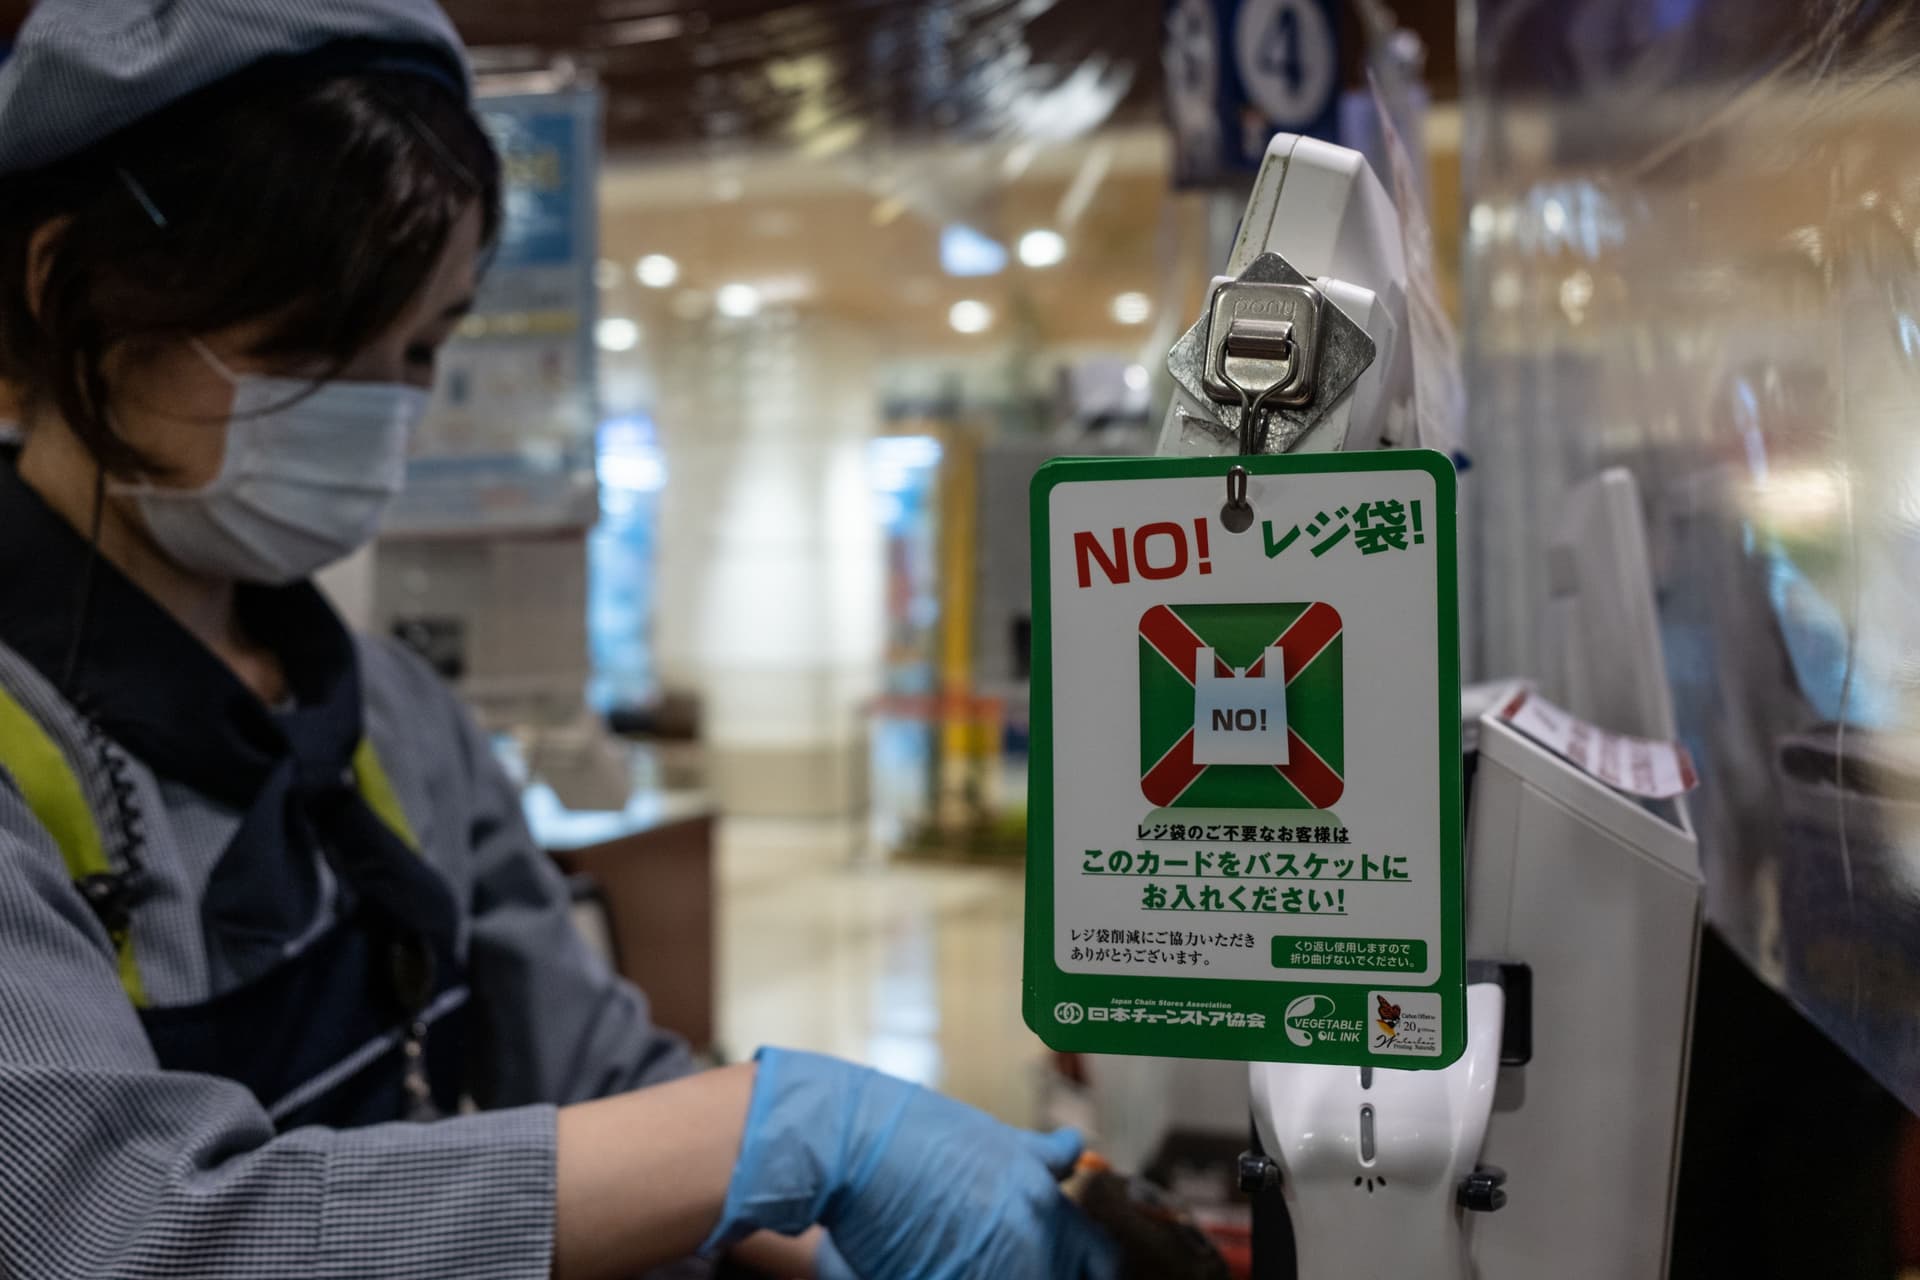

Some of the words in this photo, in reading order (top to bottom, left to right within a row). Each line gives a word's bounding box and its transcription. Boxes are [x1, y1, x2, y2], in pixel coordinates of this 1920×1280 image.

[1256, 4, 1306, 97] 4
[1073, 517, 1213, 588] NO!
[1262, 498, 1426, 559] レジ袋!
[1211, 708, 1268, 732] NO!
[1136, 823, 1350, 843] レジ袋のご不要なお客様は
[1081, 849, 1410, 881] このカードをバスケットに
[1141, 884, 1346, 914] お入れください!
[1070, 928, 1256, 949] レジ袋削減にご協力いただき
[1294, 940, 1411, 956] くり返し使用しますので
[1070, 946, 1211, 967] ありがとうございます。
[1289, 953, 1416, 968] 折り曲げないでください。
[1134, 998, 1157, 1007] Chain
[1158, 999, 1184, 1008] Stores
[1186, 1000, 1232, 1010] Association
[1088, 1007, 1265, 1028] 日本チェーンストア協会
[1294, 1018, 1364, 1031] VEGETABLE
[1318, 1030, 1337, 1042] OIL
[1340, 1031, 1360, 1043] INK
